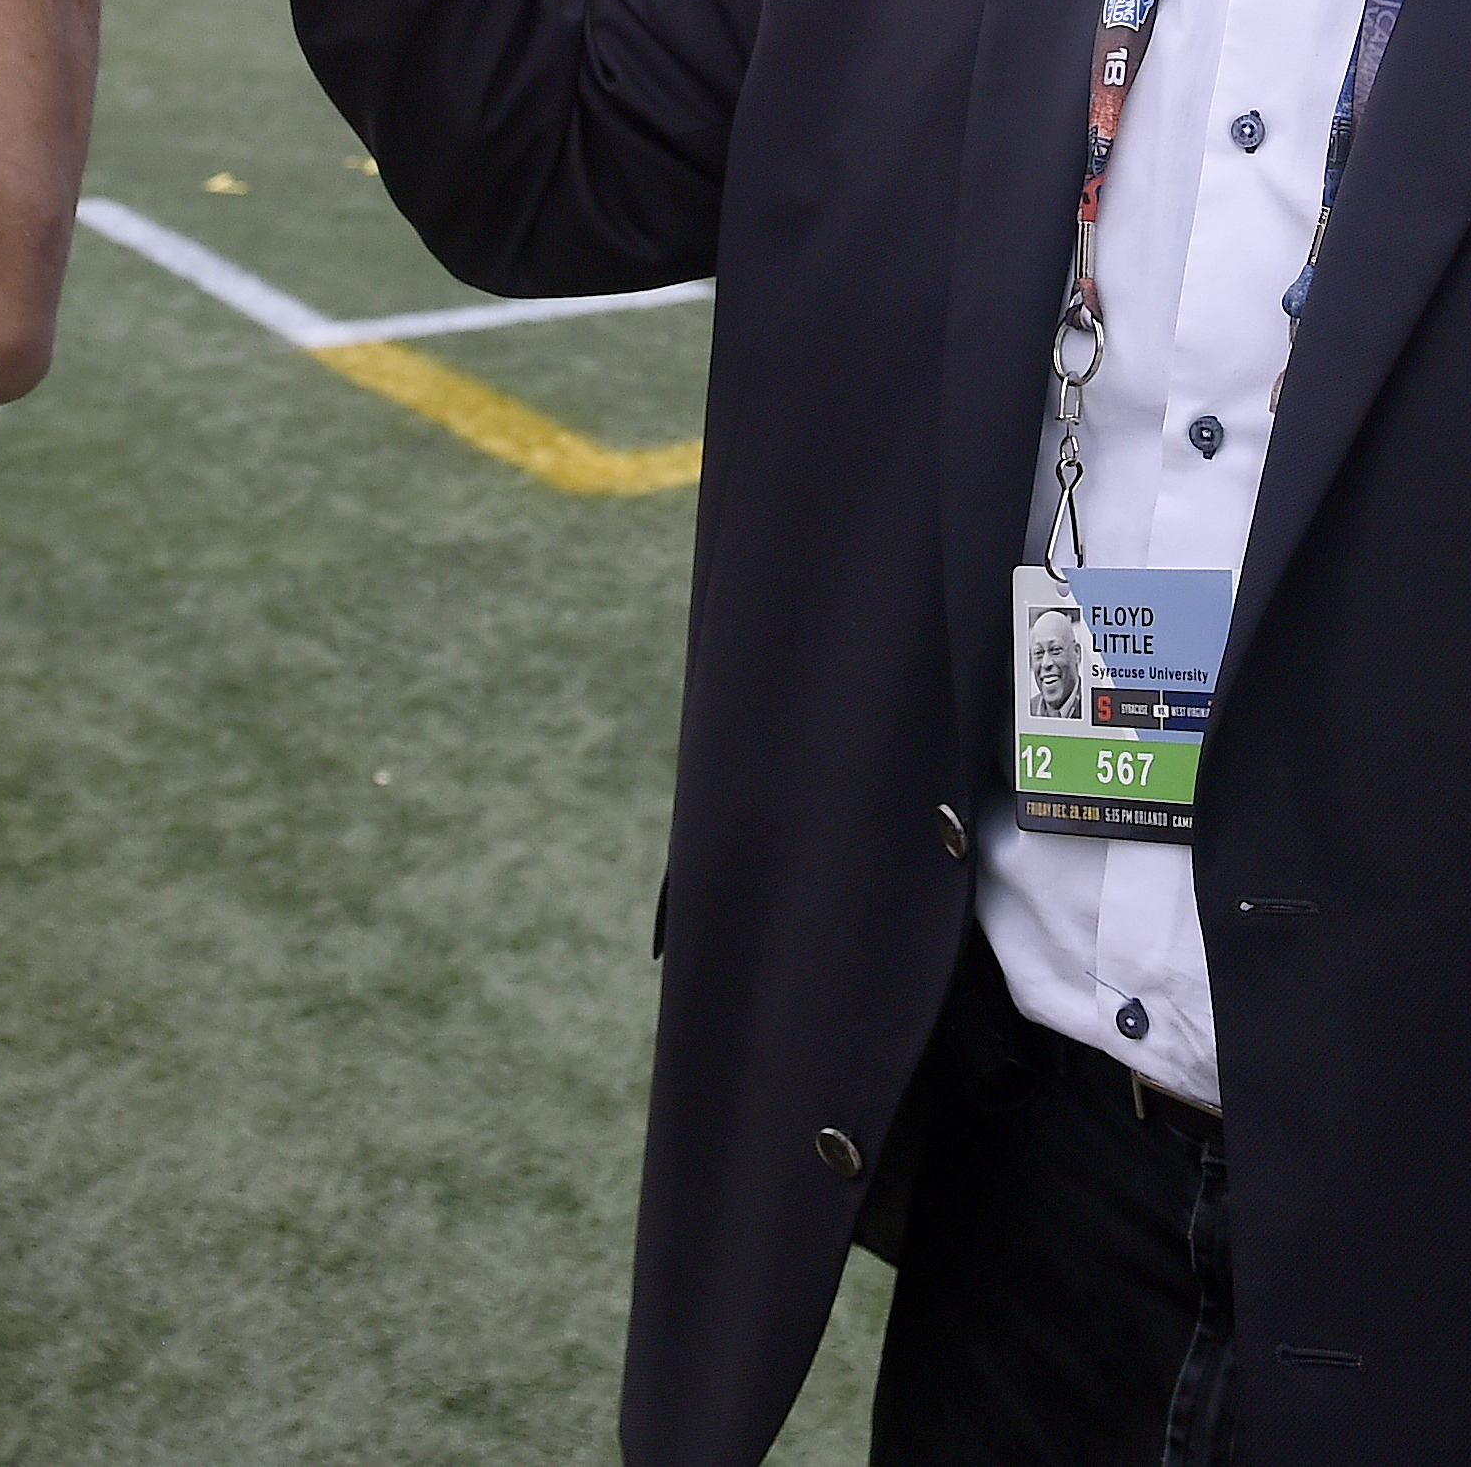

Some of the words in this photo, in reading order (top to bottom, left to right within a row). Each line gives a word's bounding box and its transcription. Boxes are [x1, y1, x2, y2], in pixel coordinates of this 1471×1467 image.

[1104, 47, 1129, 86] 18
[1091, 606, 1154, 627] FLOYD
[1091, 633, 1154, 655] LITTLE
[1091, 664, 1145, 681] Syracuse
[1149, 666, 1209, 685] University
[1097, 695, 1113, 722] S
[1021, 744, 1053, 780] 12
[1096, 749, 1155, 786] 567
[1121, 808, 1133, 825] PM
[1134, 809, 1168, 826] ORLANDO
